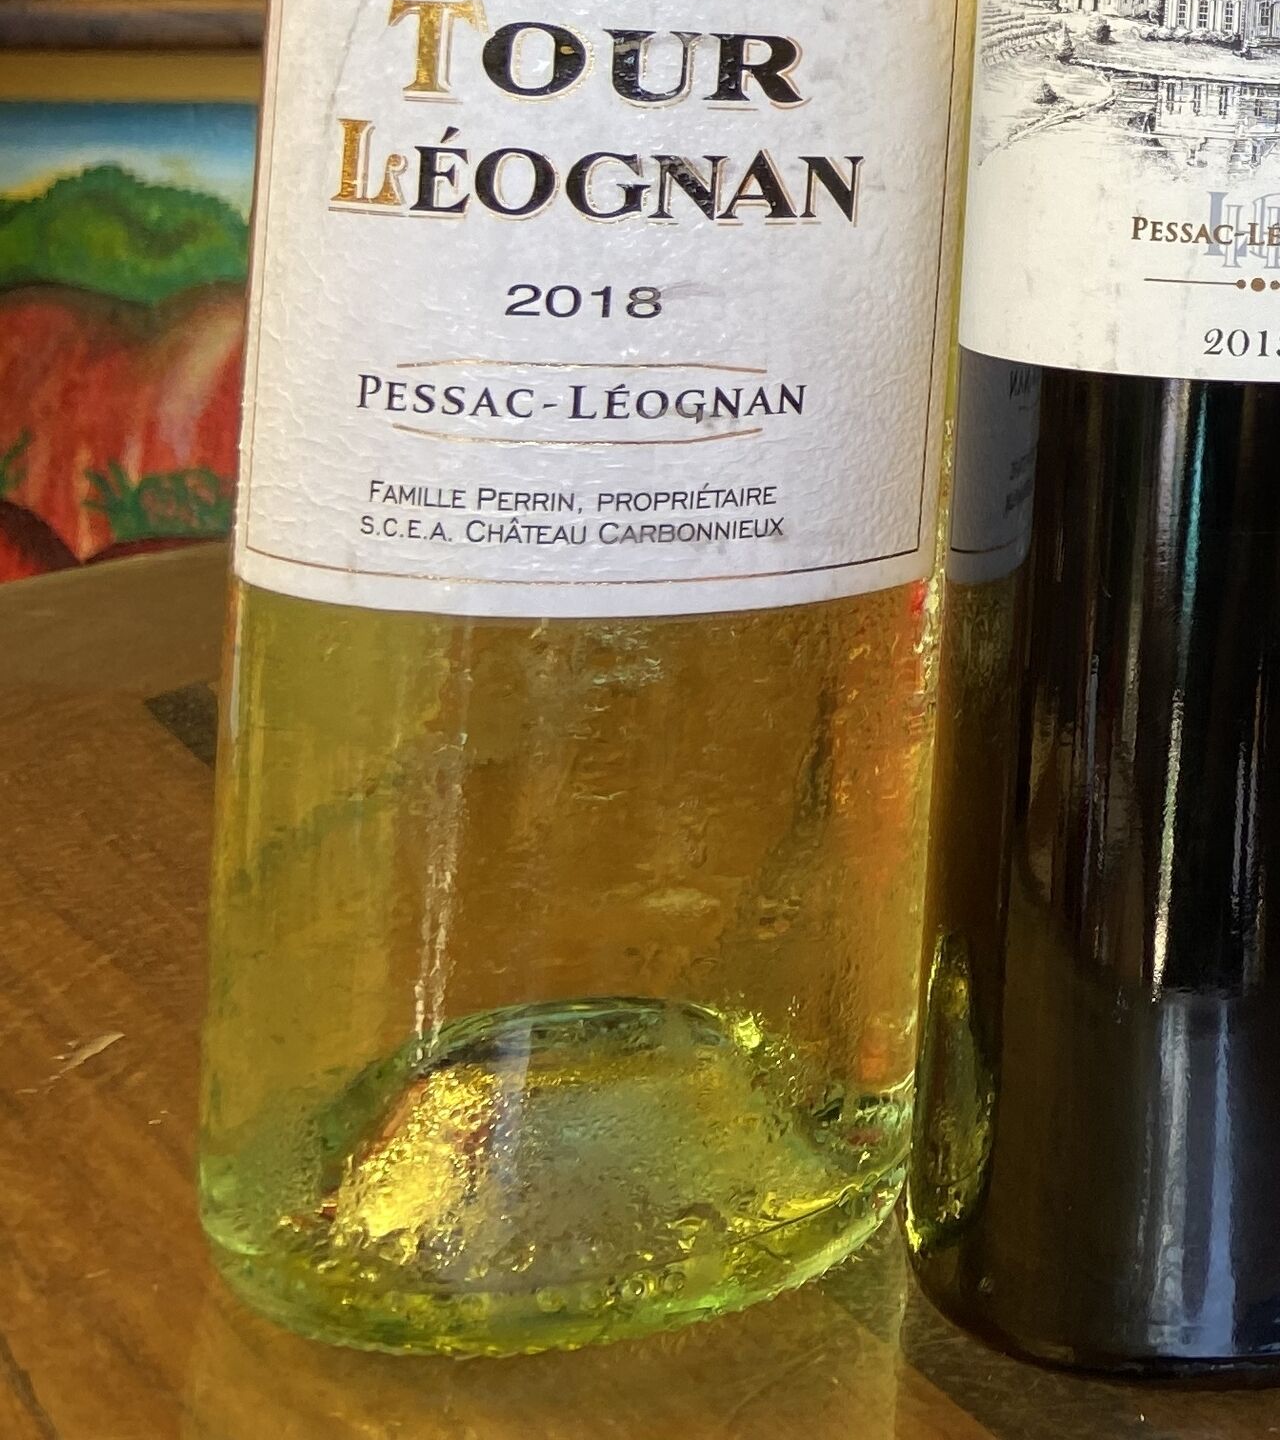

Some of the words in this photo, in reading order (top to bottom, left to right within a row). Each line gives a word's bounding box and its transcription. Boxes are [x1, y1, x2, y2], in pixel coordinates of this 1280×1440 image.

[327, 118, 865, 226] LÉOGNAN
[503, 283, 665, 320] 2018
[369, 480, 467, 510] FAMILLE
[477, 486, 584, 515] PERRIN,
[596, 483, 778, 513] PROPRIÉTAIRE
[360, 515, 453, 542] S.C.E.A.
[466, 517, 587, 546] CHÂTEAU
[598, 517, 786, 544] CARBONNIEUX
